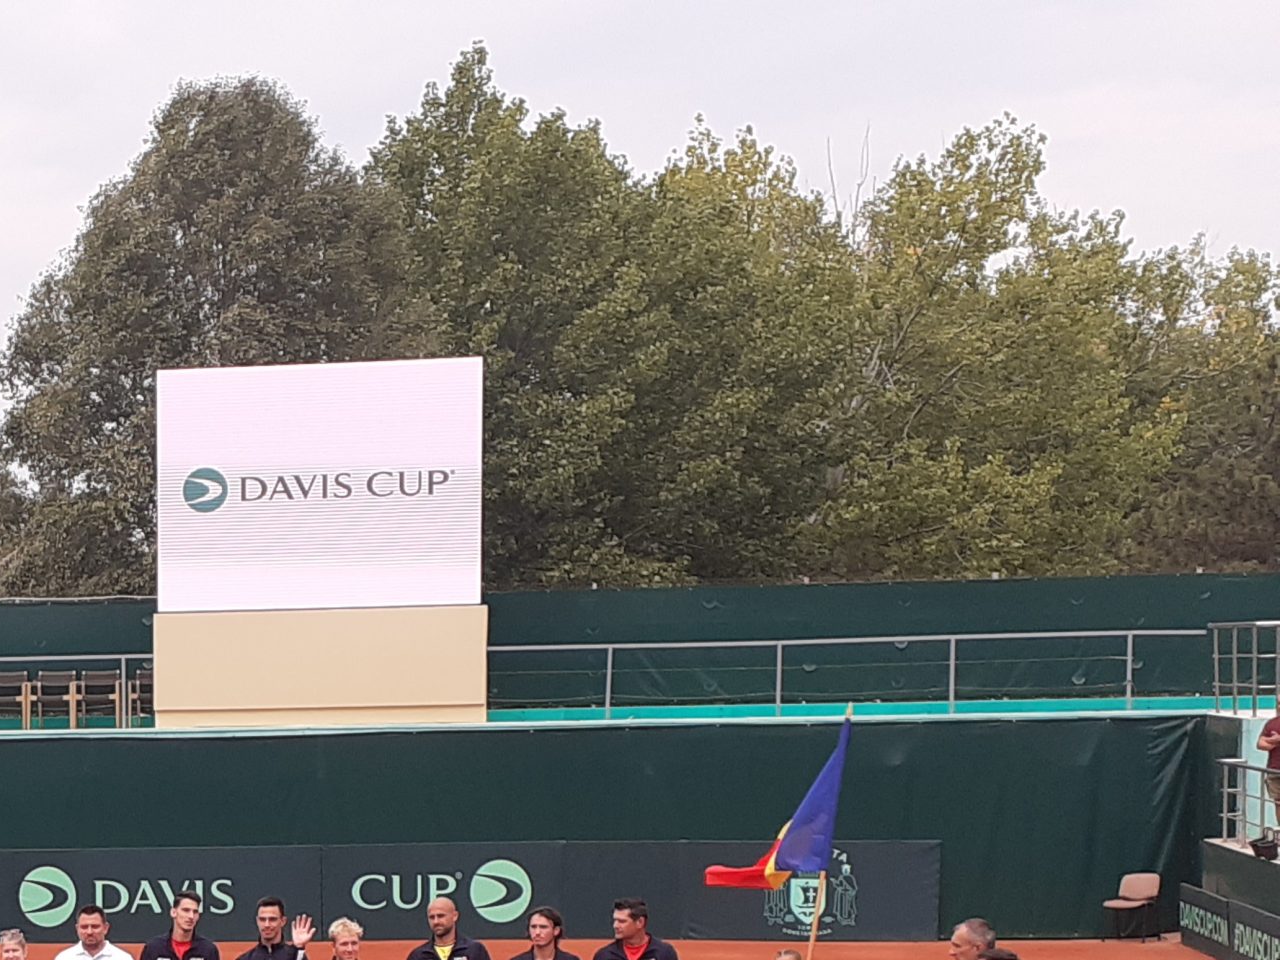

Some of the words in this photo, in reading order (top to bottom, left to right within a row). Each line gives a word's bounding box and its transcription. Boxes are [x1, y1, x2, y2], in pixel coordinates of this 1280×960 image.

[240, 472, 353, 501] DAVIS
[366, 469, 450, 498] CUP
[93, 879, 236, 914] DAVIS
[351, 874, 457, 910] CUP
